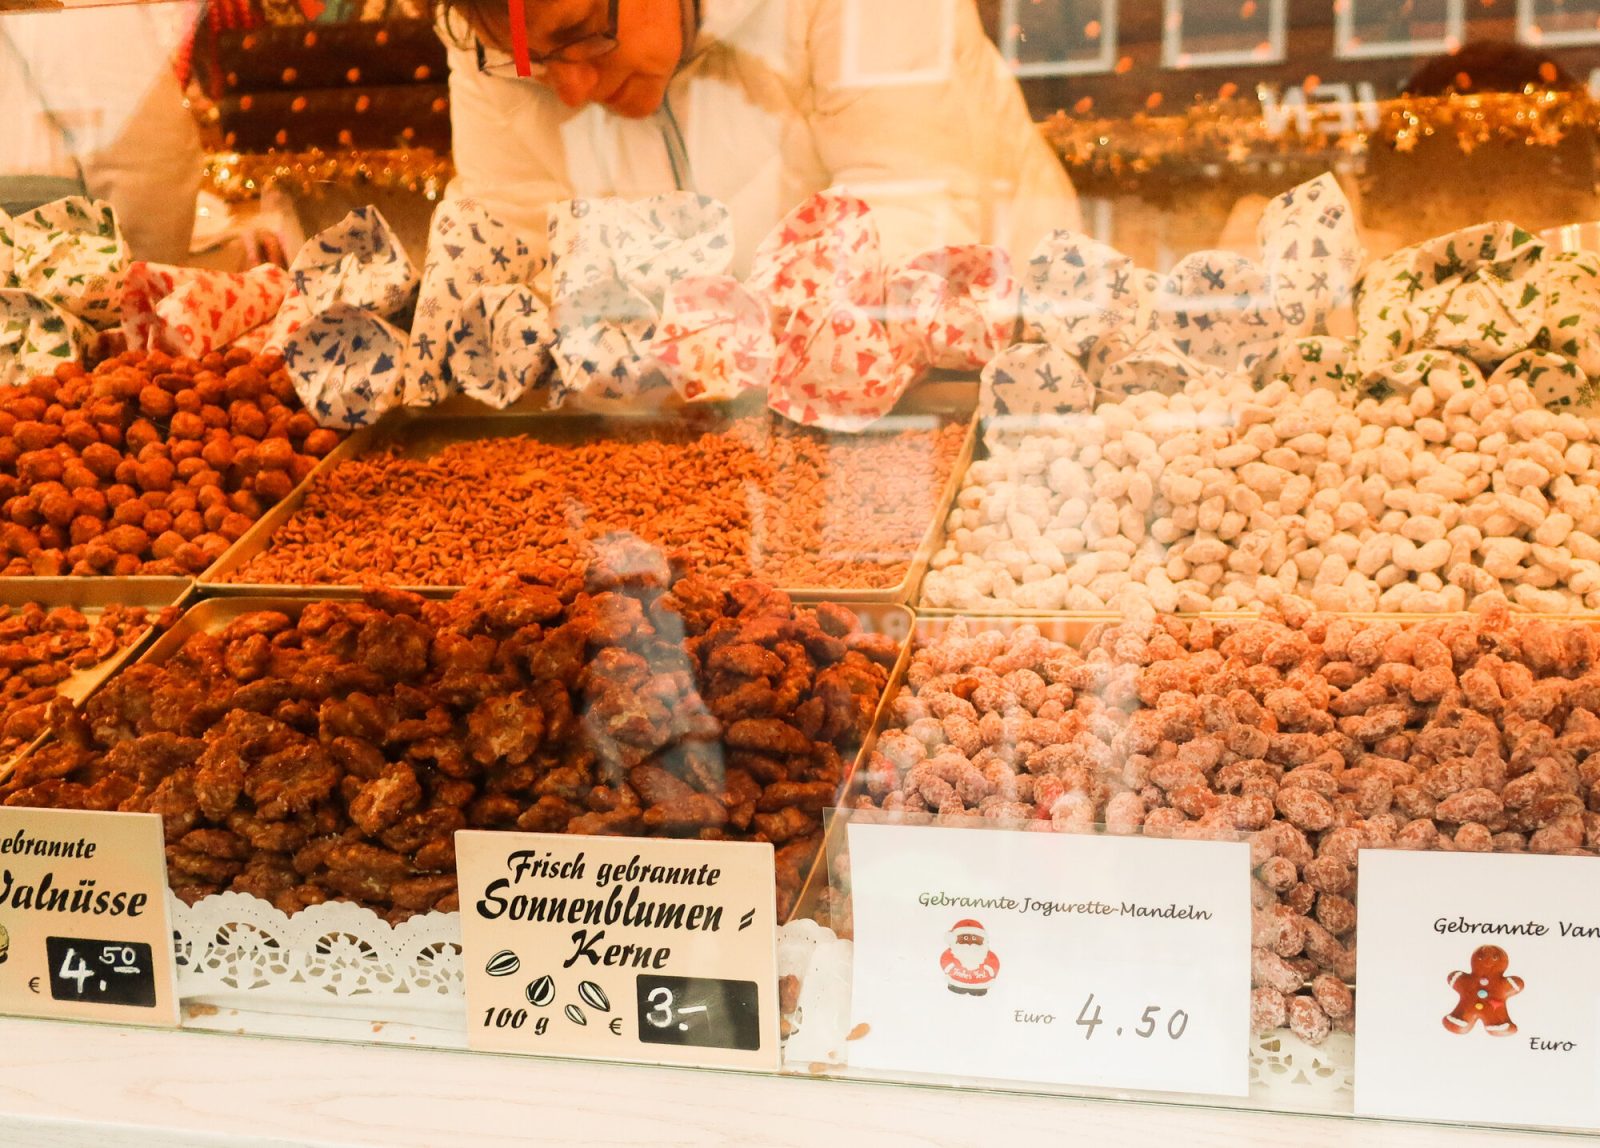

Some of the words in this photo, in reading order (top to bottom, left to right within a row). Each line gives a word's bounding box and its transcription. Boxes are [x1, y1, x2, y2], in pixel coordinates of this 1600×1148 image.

[0, 829, 97, 859] ebrannte
[507, 850, 585, 884] Frisch
[596, 855, 721, 887] gebrannte
[476, 878, 723, 931] Sonnenblumen
[918, 892, 1018, 911] Gebrannte
[1018, 897, 1213, 921] Jogurette-Mandeln
[1433, 916, 1550, 936] Gebrannte
[563, 929, 671, 969] Kerne
[28, 976, 41, 994] €
[483, 1007, 528, 1029] 100
[534, 1015, 549, 1036] g
[609, 1017, 623, 1035] €
[1014, 1010, 1056, 1024] Euro
[1530, 1037, 1577, 1051] Euro
